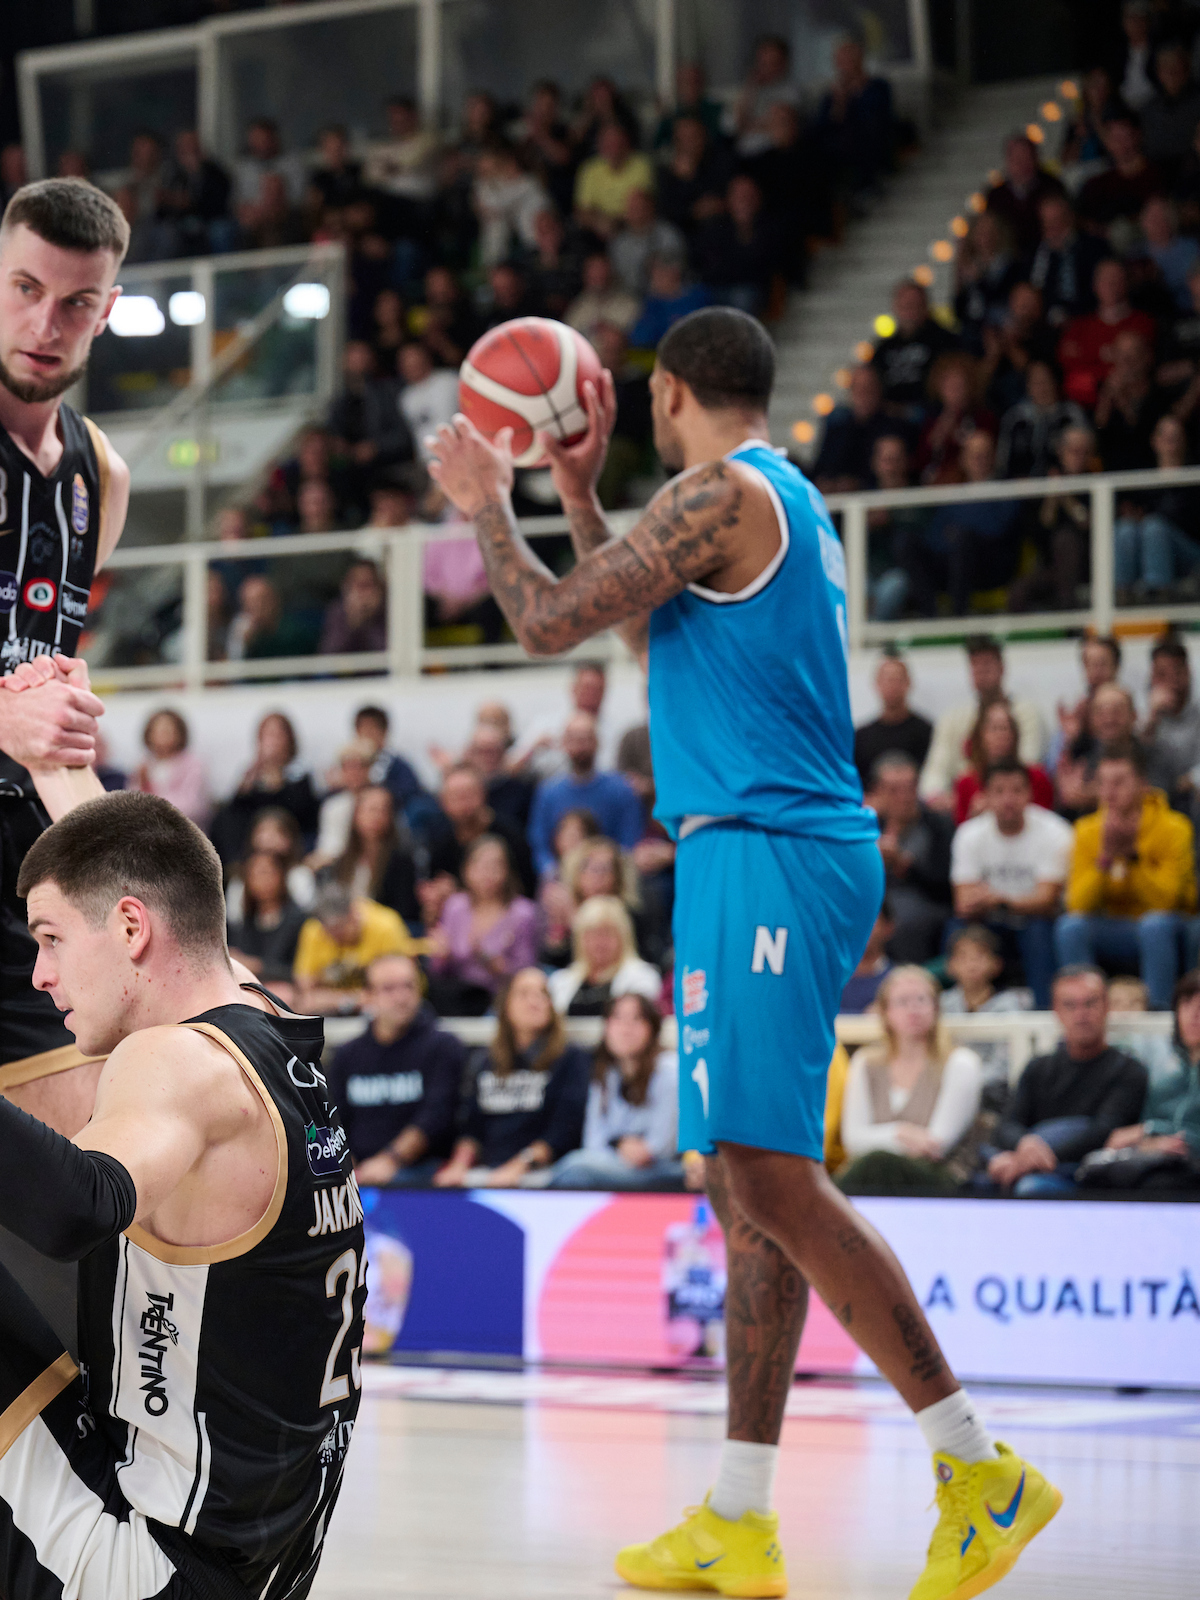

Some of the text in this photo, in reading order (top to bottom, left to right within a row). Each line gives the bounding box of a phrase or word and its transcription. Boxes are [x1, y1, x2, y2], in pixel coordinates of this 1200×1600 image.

[751, 925, 788, 976] N
[974, 1266, 1200, 1326] QUALITÀ
[138, 1290, 174, 1416] TRENTINO
